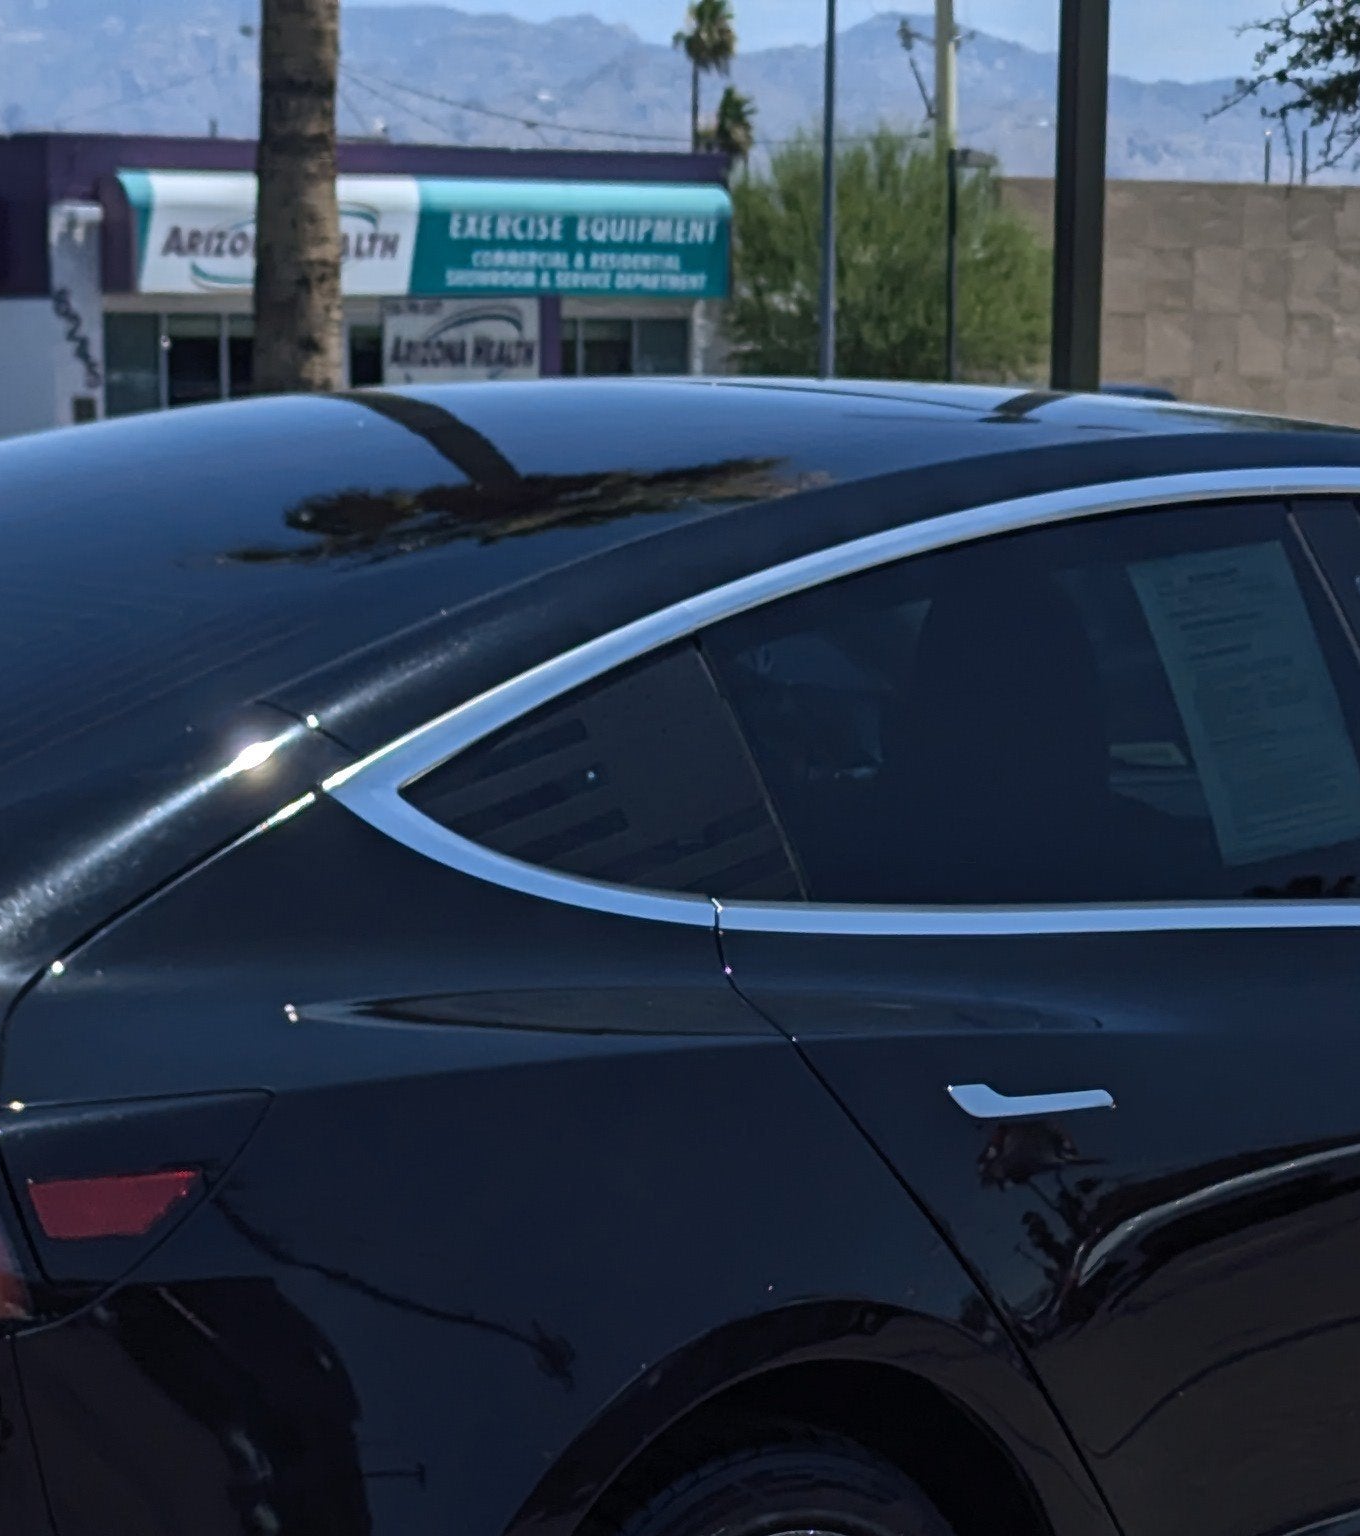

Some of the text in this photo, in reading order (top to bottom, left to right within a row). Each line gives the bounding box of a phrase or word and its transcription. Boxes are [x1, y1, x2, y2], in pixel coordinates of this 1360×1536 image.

[161, 225, 400, 258] ARIZO ALTH
[449, 214, 717, 244] EXERCISE EQUIPMENT
[471, 250, 568, 269] COMMERCIAL
[590, 253, 681, 271] RESIDENTIAL
